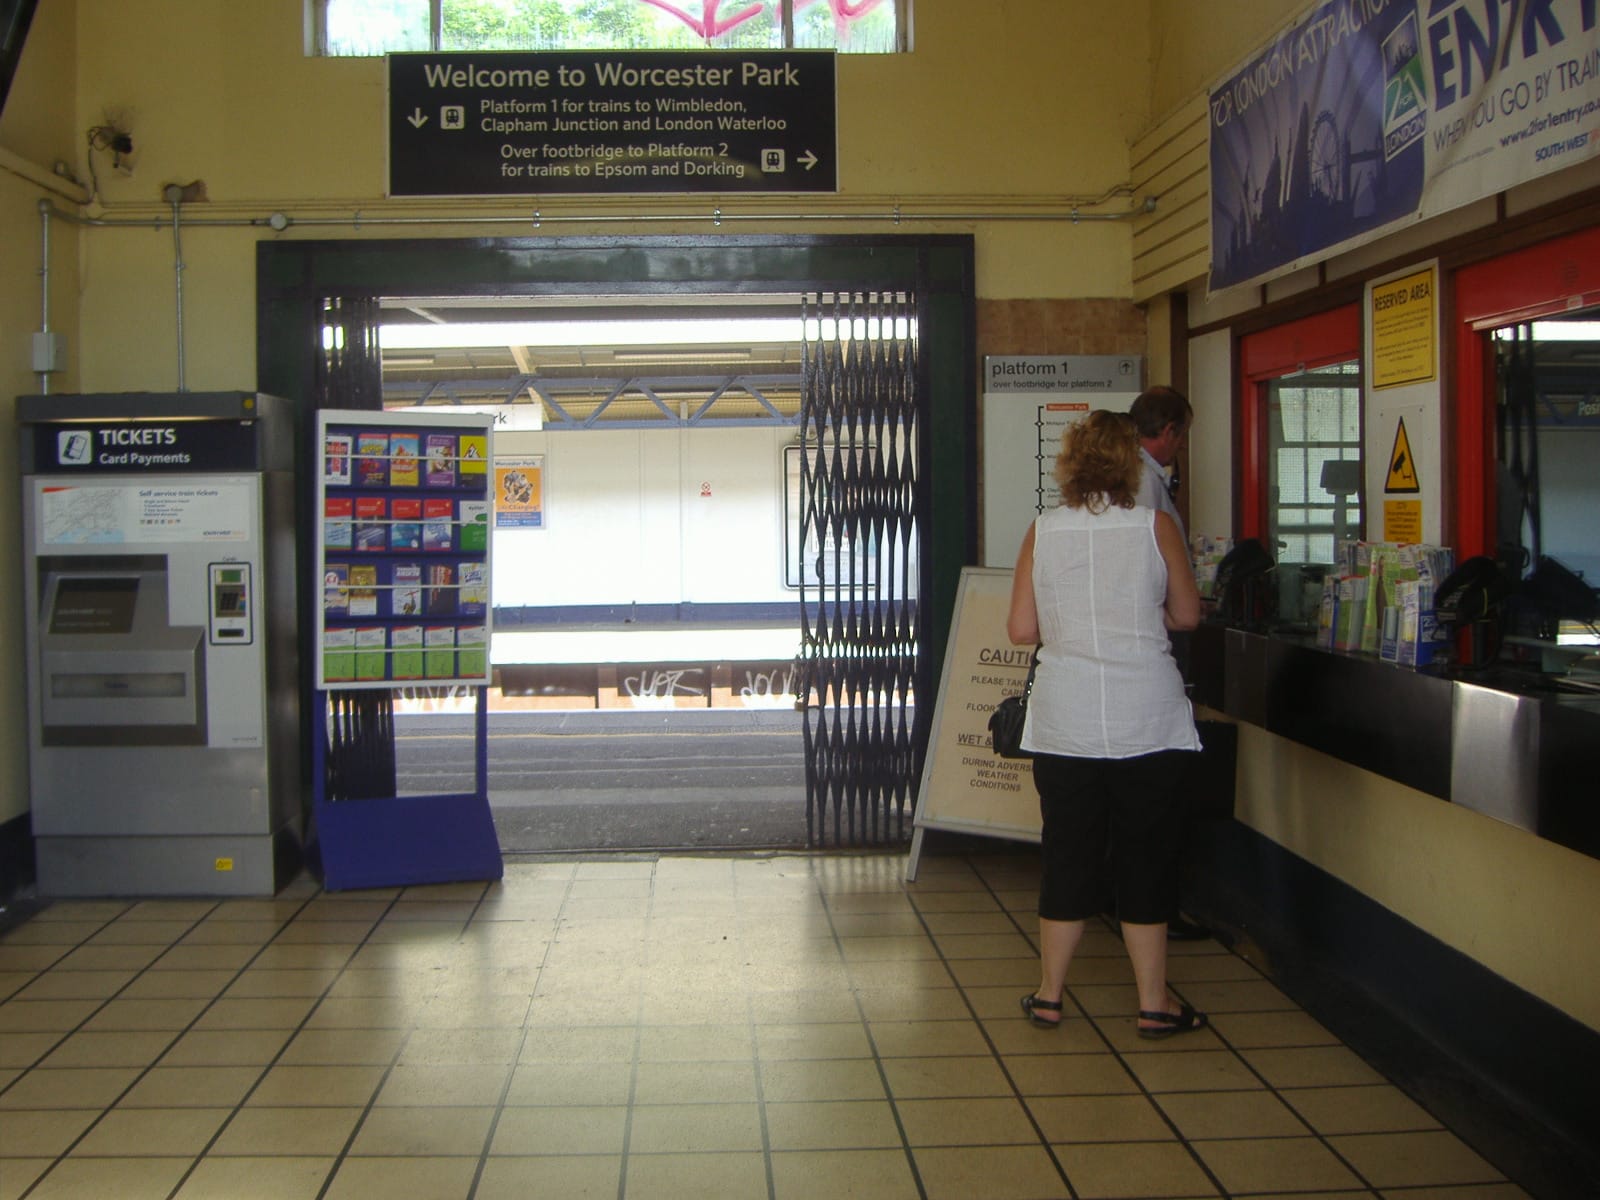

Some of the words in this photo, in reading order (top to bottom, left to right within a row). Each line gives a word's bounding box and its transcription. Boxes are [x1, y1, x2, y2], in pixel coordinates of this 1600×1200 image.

[424, 63, 549, 88] Welcome
[557, 64, 585, 88] to
[594, 62, 733, 88] Worcester
[742, 62, 800, 87] Park
[1212, 92, 1232, 127] TOP
[1233, 41, 1293, 114] LONDON
[1501, 82, 1530, 115] GO
[1536, 69, 1551, 103] BY
[480, 98, 547, 113] Platform
[551, 98, 558, 112] 1
[561, 98, 584, 113] for
[588, 98, 631, 113] trains
[634, 99, 651, 113] to
[655, 97, 747, 114] Wimbledon,
[480, 117, 548, 134] Clapham
[552, 116, 619, 132] Junction
[622, 117, 651, 131] and
[655, 116, 713, 131] London
[717, 115, 787, 131] Waterloo
[1387, 119, 1425, 153] LONDON
[500, 143, 537, 159] Over
[542, 143, 624, 161] footbridge
[627, 144, 644, 158] to
[648, 142, 714, 158] Platform
[718, 142, 729, 157] 2
[1535, 142, 1565, 162] SOUTH
[1567, 132, 1589, 150] WEST
[501, 162, 524, 177] for
[528, 163, 570, 177] trains
[574, 163, 591, 176] to
[595, 162, 648, 179] Epsom
[651, 161, 680, 176] and
[684, 161, 745, 178] Dorking
[1375, 289, 1408, 312] RESERVED
[1410, 282, 1430, 303] AREA
[992, 361, 1056, 377] platform
[1061, 361, 1069, 374] 1
[1013, 380, 1056, 389] footbridge
[1058, 380, 1070, 388] for
[1071, 380, 1105, 389] platform
[1106, 380, 1113, 388] 2
[99, 428, 177, 446] TICKETS
[99, 452, 128, 464] Card
[130, 452, 191, 466] Payments
[979, 648, 1033, 665] CAUTI
[971, 675, 1003, 686] PLEASE
[966, 703, 996, 712] FLOOR
[958, 733, 983, 745] WET
[962, 757, 995, 768] DURING
[997, 761, 1033, 772] ADVERS
[977, 769, 1018, 781] WEATHER
[970, 779, 1021, 792] CONDITIONS
